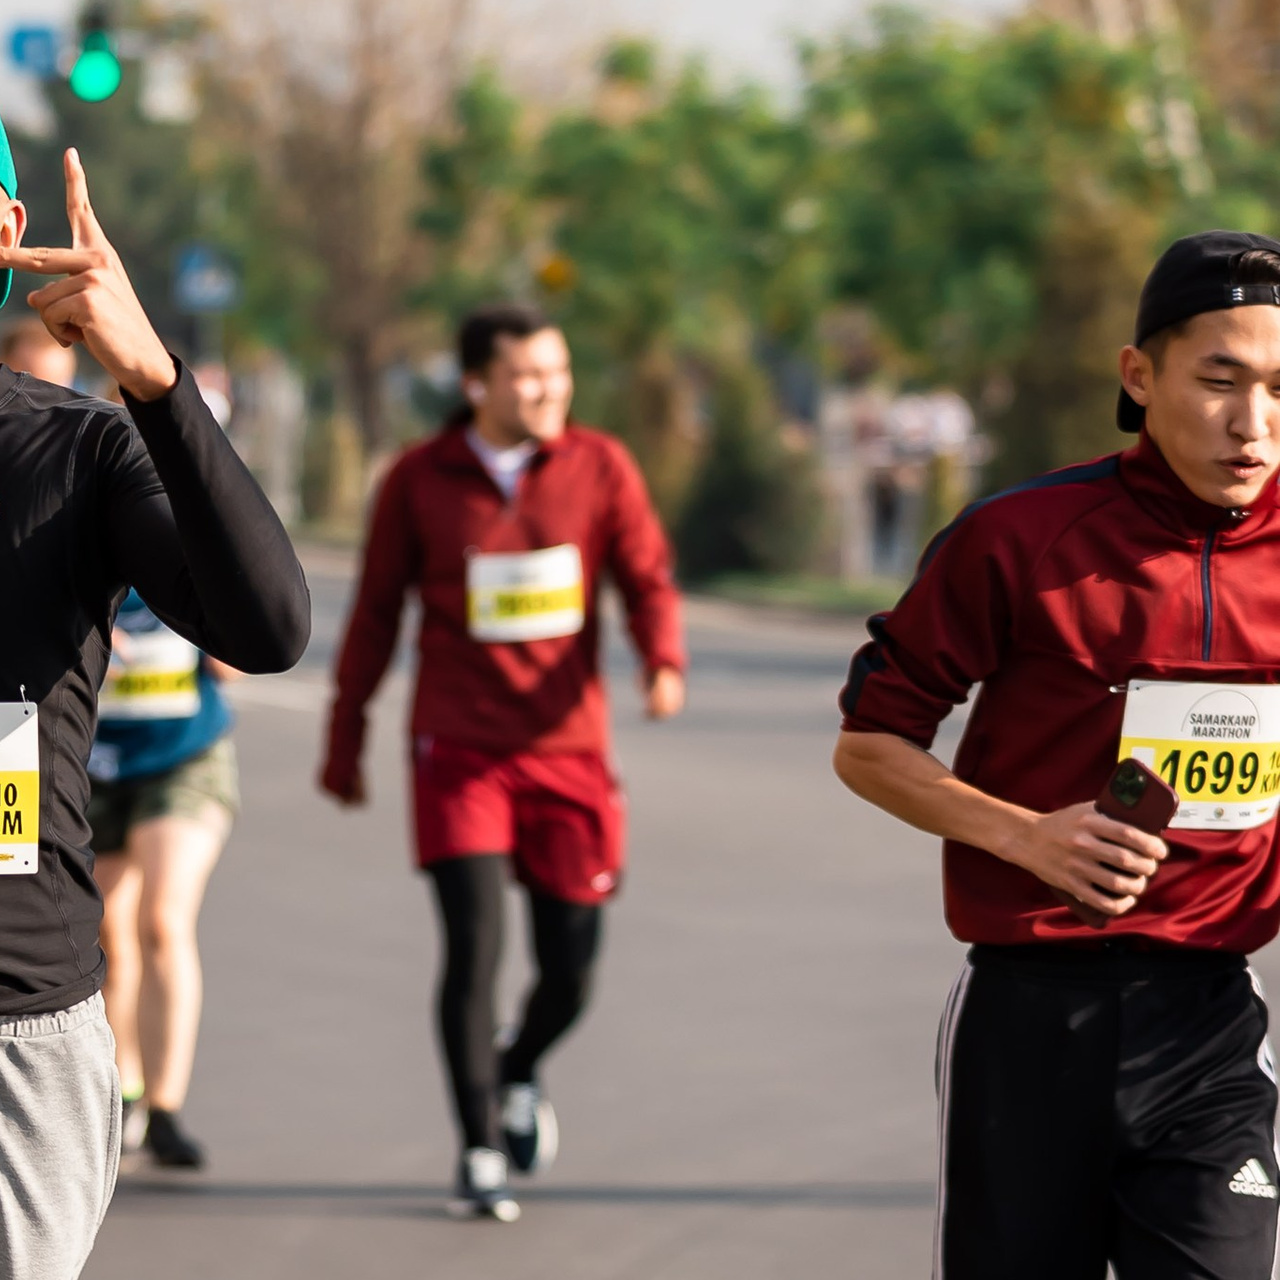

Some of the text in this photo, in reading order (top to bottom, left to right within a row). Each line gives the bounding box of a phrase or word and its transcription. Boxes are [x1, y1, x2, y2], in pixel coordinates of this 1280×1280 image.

[1189, 713, 1256, 726] SAMARKAND
[1191, 726, 1251, 739] MARATHON
[1160, 749, 1259, 795] 1699
